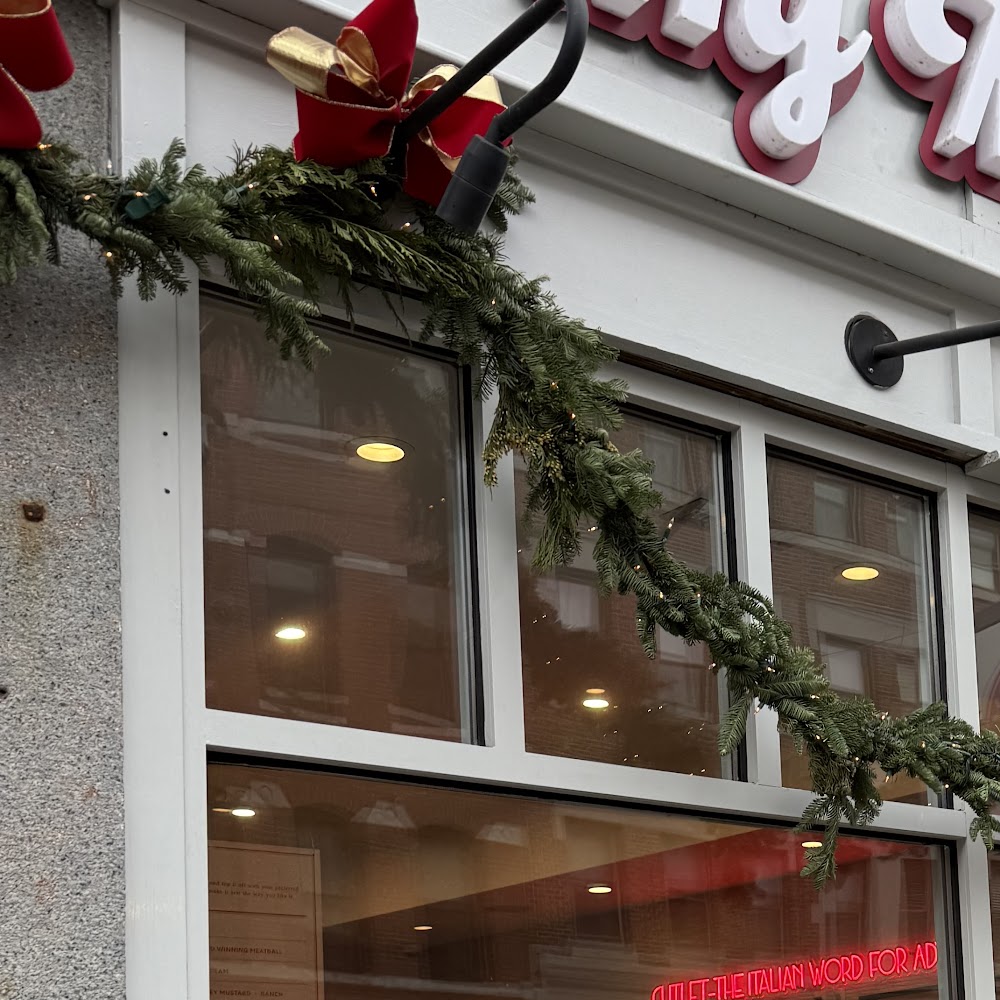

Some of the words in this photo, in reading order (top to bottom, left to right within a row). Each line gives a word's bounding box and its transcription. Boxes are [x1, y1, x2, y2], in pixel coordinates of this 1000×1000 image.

[747, 963, 805, 996] ITALIAN
[809, 954, 863, 987] WORD
[869, 947, 908, 978] FOR
